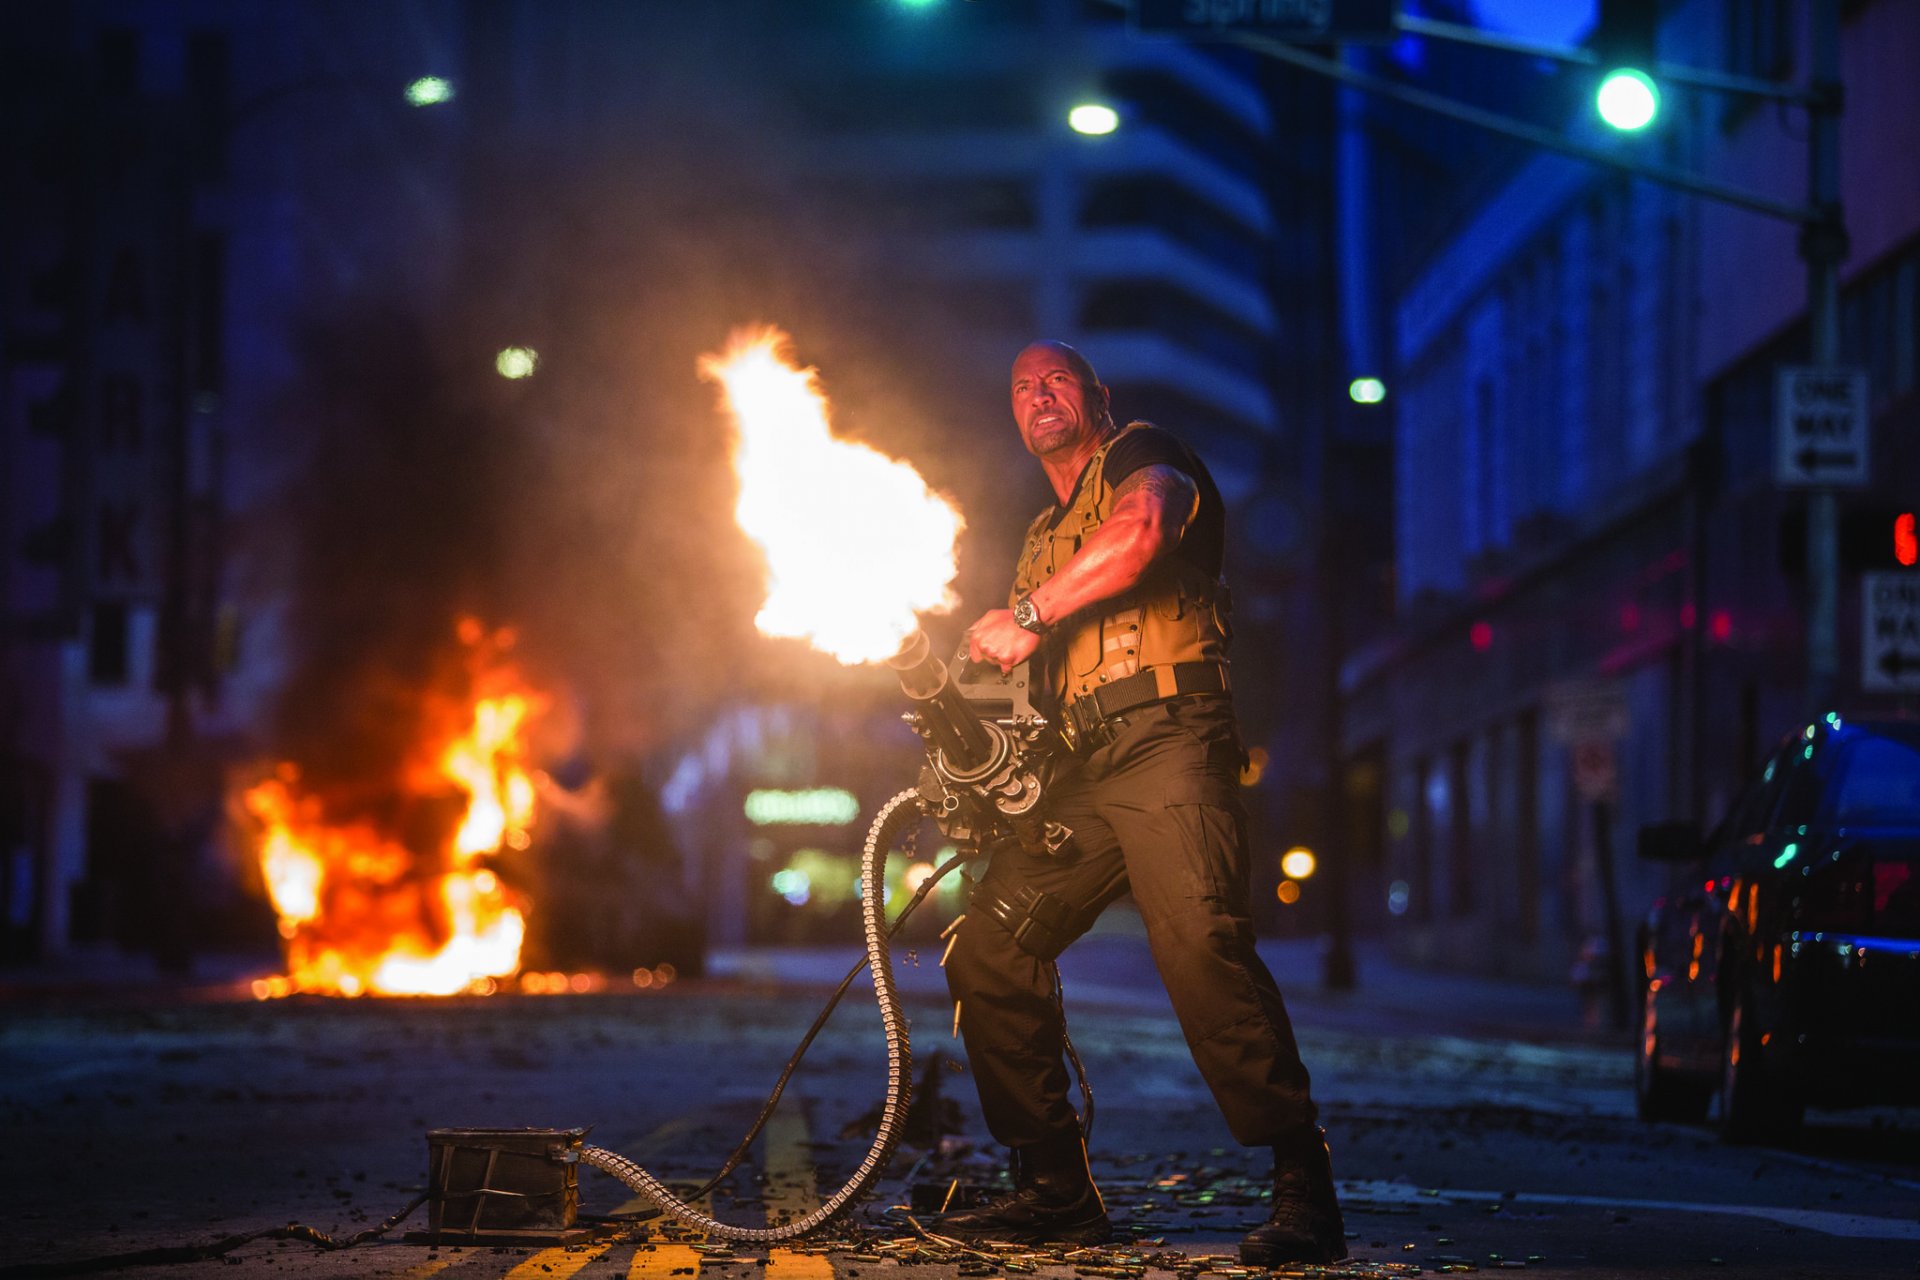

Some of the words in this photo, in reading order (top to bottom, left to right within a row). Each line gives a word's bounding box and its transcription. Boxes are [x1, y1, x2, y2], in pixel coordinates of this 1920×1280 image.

[1184, 0, 1333, 35] Spring
[1794, 380, 1852, 402] ONE
[1794, 415, 1852, 437] WAY
[1875, 585, 1920, 607] ON
[1876, 616, 1920, 638] WA
